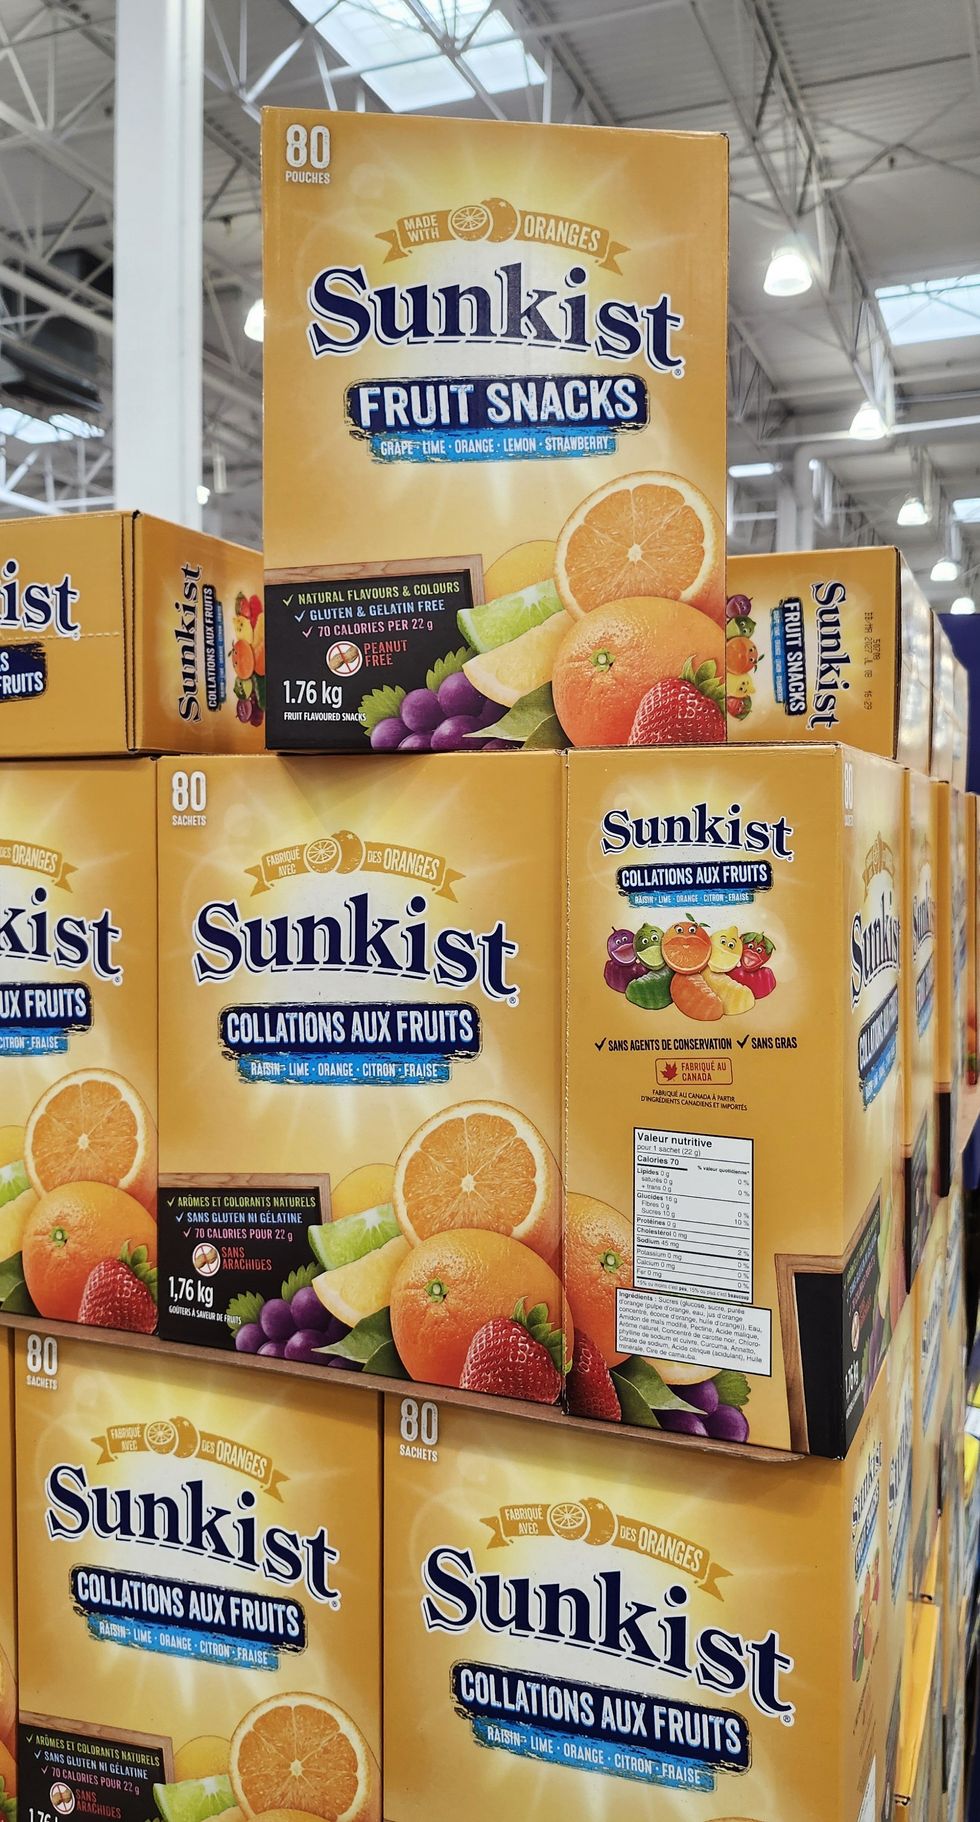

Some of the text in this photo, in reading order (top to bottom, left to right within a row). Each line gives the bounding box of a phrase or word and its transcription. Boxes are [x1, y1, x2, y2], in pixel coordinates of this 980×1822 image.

[285, 124, 331, 169] 80
[285, 171, 330, 184] POUCHES
[403, 215, 600, 251] MADE ORANGES
[407, 227, 440, 243] WITH
[309, 262, 685, 371] Sunkist
[359, 379, 638, 427] FRUIT SNACKS
[380, 436, 609, 457] GRAPE LIME ORANGE LEMON STRAWBERRY
[298, 581, 460, 605] NATURAL FLAVOURS & COLOURS
[310, 600, 445, 622] GLUTEN & GELATIN FREE
[317, 618, 433, 637] 70 CALORIES PER 22 g
[175, 563, 201, 722] Sunkist
[203, 587, 217, 707] COLLATIONS AUX FRUITS
[364, 640, 407, 655] PEANUT
[365, 653, 393, 667] FREE
[784, 602, 806, 712] FRUIT SNACKS
[807, 580, 850, 729] Sunkist
[0, 671, 44, 694] RUITS
[283, 680, 343, 709] 1.76 kg
[284, 712, 367, 722] FRUIT FLAVOURED SNACKS
[172, 771, 207, 811] 80
[172, 815, 207, 826] SACHETS
[601, 802, 793, 857] Sunkist
[12, 844, 58, 873] ORANGES
[266, 847, 440, 880] FABRIQUÉ DES ORANGES
[278, 863, 297, 877] AVEC
[622, 864, 768, 888] COLLATIONS AUX FRUITS
[194, 892, 517, 997] Sunkist
[25, 988, 87, 1018] FRUITS
[227, 1010, 473, 1044] COLLATIONS AUX FRUITS
[31, 1036, 59, 1049] FRAISE
[608, 1037, 797, 1052] SANS AGENTS DE CONSERVATION SANS GRAS
[251, 1063, 438, 1077] RAISIN LIME ORANGE CITRON FRAISE
[681, 1061, 727, 1072] FABRIQUÉ AU
[682, 1073, 712, 1082] CANADA
[641, 1096, 680, 1105] D'INGRÉDIENTS
[681, 1099, 712, 1108] CANADIENS
[720, 1103, 748, 1111] IMPORTÉS
[652, 1089, 678, 1098] FABRIQUÉ
[717, 1094, 736, 1102] PARTIR
[637, 1132, 712, 1148] Valeur nutritive
[637, 1155, 679, 1166] Calories 70
[659, 1146, 680, 1154] sachet
[694, 1149, 701, 1157] g)
[177, 1194, 316, 1208] ARÔMES ET COLORANTS NATURELS
[187, 1209, 302, 1224] SANS GLUTEN NI GÉLATINE
[195, 1228, 293, 1242] 70 CALORIES POUR 22 g
[637, 1237, 659, 1245] Sodium
[670, 1241, 679, 1249] mg
[221, 1247, 245, 1258] SANS
[222, 1259, 272, 1271] ARACHIDES
[168, 1276, 214, 1308] 1,76 kg
[168, 1305, 242, 1325] GOÛTERS À SAVEUR DE FRUITS
[26, 1335, 58, 1376] 80
[26, 1375, 58, 1390] SACHETS
[400, 1398, 438, 1446] 80
[399, 1444, 438, 1462] SACHETS
[47, 1465, 339, 1601] Sunkist
[505, 1504, 703, 1571] FABRIQUÉ DES ORANGES
[518, 1521, 539, 1536] AVEC
[77, 1571, 299, 1638] COLLATIONS AUX FRUITS
[423, 1548, 792, 1715] Sunkist
[460, 1668, 742, 1755] COLLATIONS AUX FRUITS
[36, 1734, 160, 1767] ARÔMES ET COLORANTS NATURELS
[487, 1725, 701, 1784] RAISIN LIME ORANGE CITRON FRAISE
